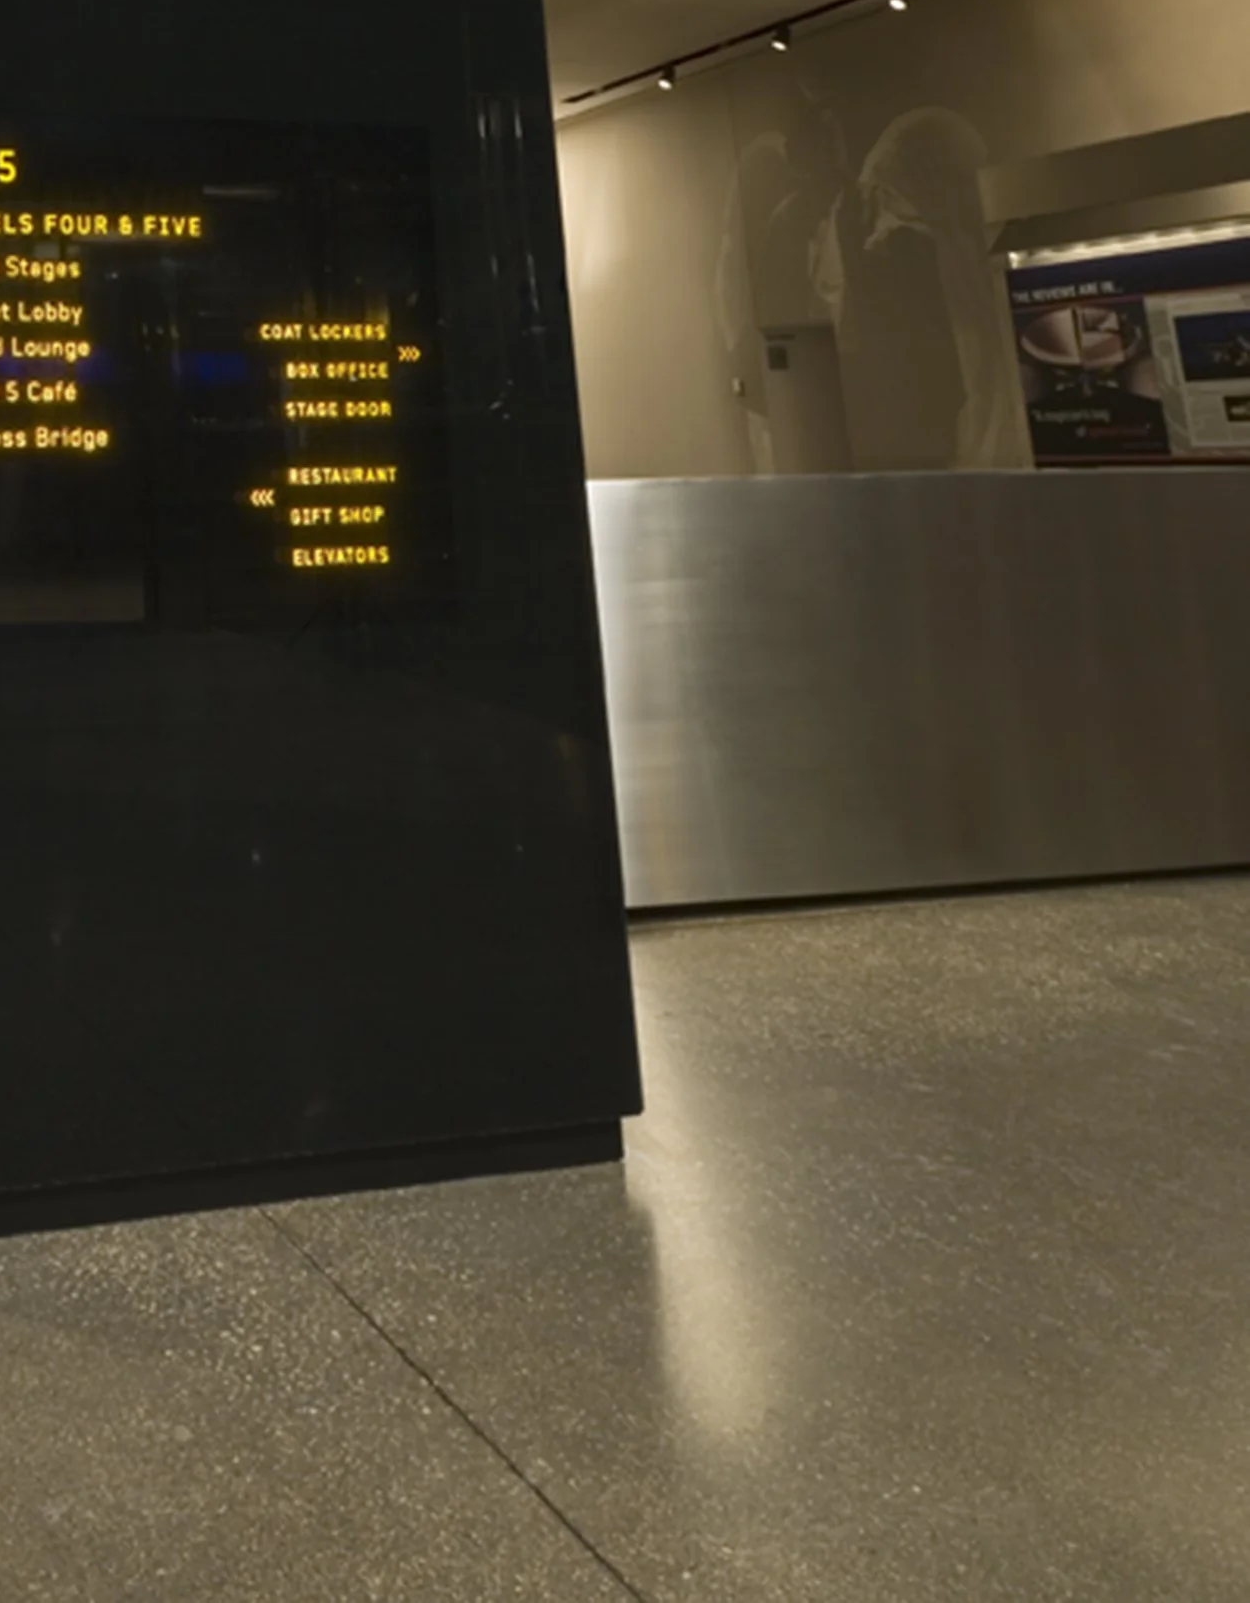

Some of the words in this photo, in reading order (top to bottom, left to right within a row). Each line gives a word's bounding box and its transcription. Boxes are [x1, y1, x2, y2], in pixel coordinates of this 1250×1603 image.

[44, 214, 108, 236] FOUR
[143, 215, 200, 237] FIVE
[5, 255, 80, 282] Stages
[18, 302, 82, 325] Lobby
[260, 324, 302, 340] COAT
[309, 322, 386, 340] LOCKERS
[11, 337, 91, 362] Lounge
[286, 362, 319, 379] BOX
[325, 362, 388, 379] OFFICE
[27, 380, 77, 402] Café
[285, 401, 338, 418] STAGE
[345, 401, 391, 417] DOOR
[34, 425, 108, 452] Bridge
[288, 467, 396, 485] RESTAURANT
[290, 507, 332, 525] GIFT
[338, 506, 384, 524] SHOP
[292, 546, 389, 566] ELEVATORS
